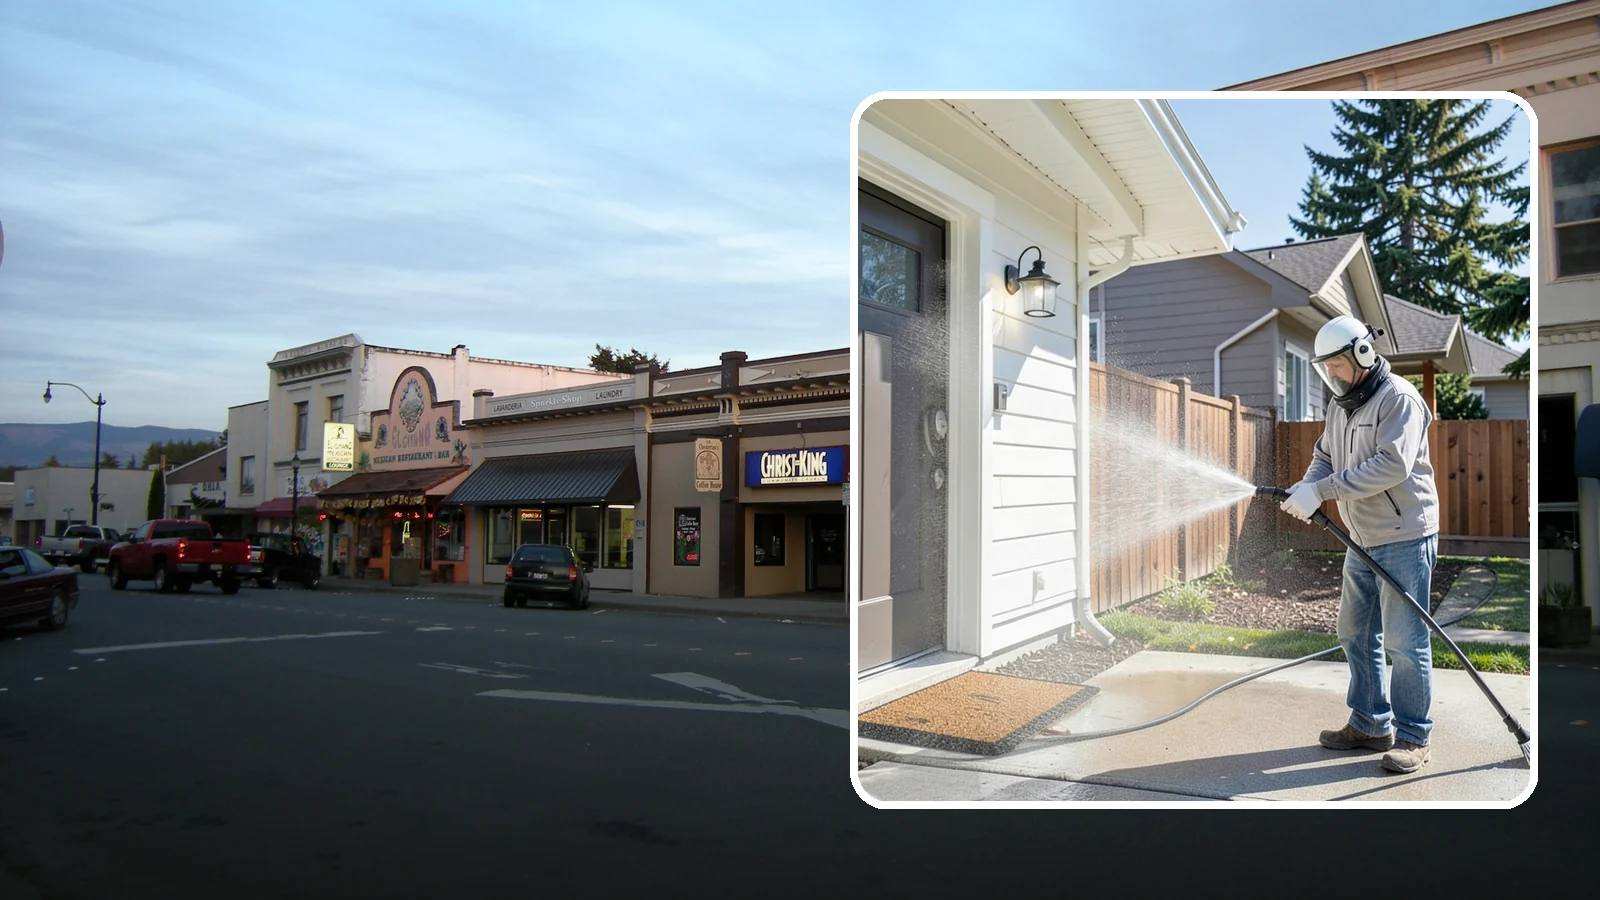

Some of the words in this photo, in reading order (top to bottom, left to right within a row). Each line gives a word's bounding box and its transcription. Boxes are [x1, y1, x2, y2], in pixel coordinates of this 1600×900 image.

[562, 394, 582, 404] Shop
[596, 389, 623, 399] LAUNDRY
[493, 403, 523, 412] LAVANDERIA
[374, 455, 396, 464] MEXICAN
[398, 452, 433, 462] RESTAURANT
[438, 450, 450, 459] BAR
[761, 452, 797, 477] CHRIST
[799, 450, 827, 476] KING
